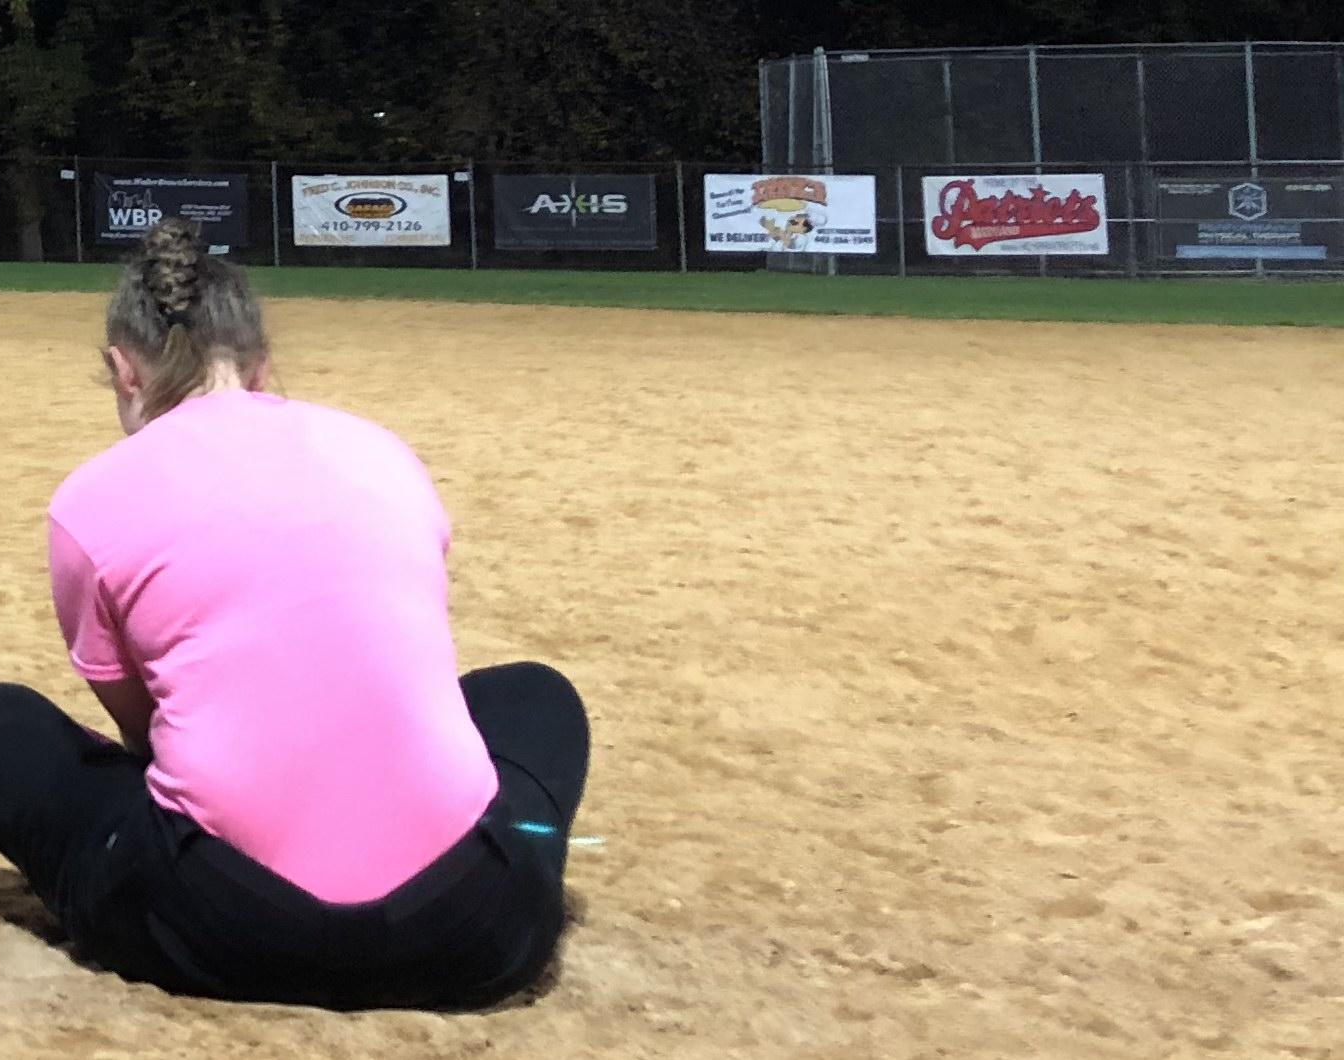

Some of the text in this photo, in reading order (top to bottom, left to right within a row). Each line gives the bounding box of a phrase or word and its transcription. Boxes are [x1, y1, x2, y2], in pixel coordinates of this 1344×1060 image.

[109, 208, 163, 226] WBR
[931, 178, 1099, 249] Patriots
[320, 220, 422, 232] 410-799-2126
[710, 233, 724, 243] WE
